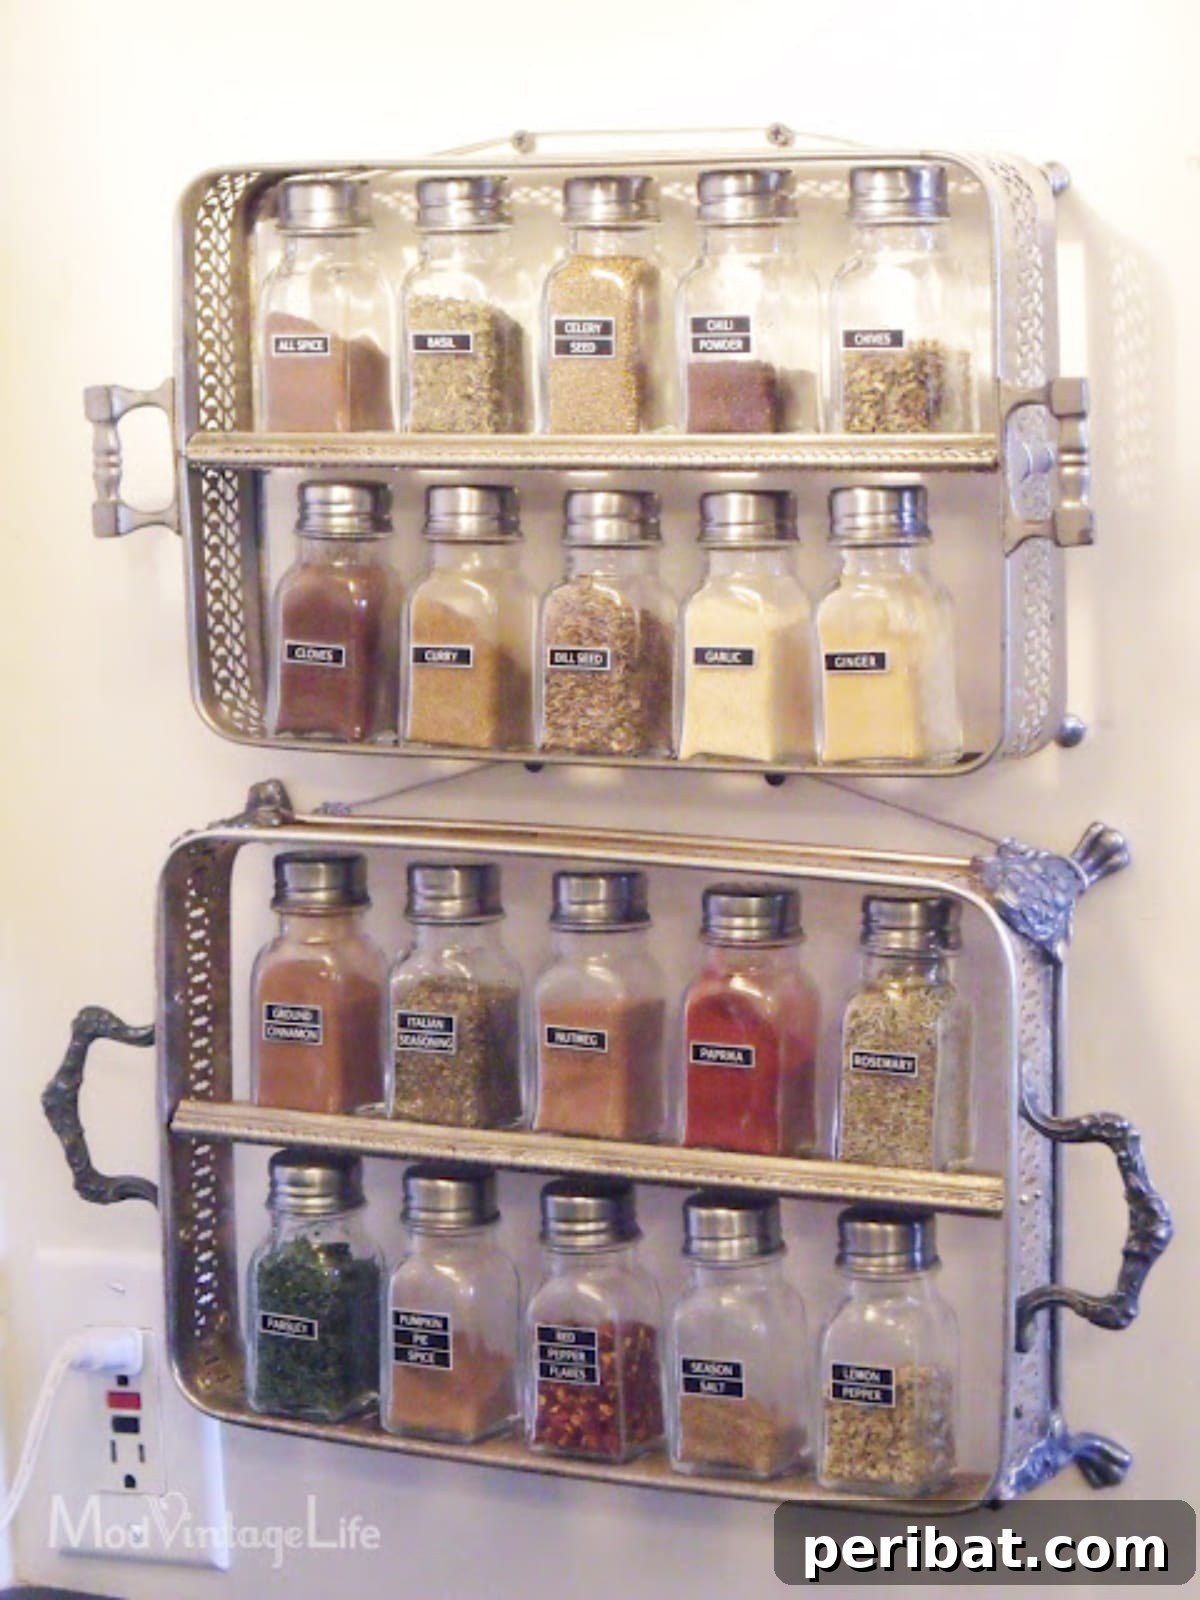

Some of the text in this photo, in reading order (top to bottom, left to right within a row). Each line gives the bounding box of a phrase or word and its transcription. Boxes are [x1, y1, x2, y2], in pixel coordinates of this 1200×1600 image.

[565, 322, 602, 333] CELERY
[569, 341, 596, 353] SEED
[699, 339, 743, 351] POWDER
[295, 647, 333, 661] CLOVES
[425, 649, 458, 661] CURRY
[577, 652, 603, 664] SEED
[705, 650, 742, 663] GARLIC
[834, 655, 876, 667] GINGER
[271, 1008, 313, 1022] GROUND
[407, 1015, 444, 1029] ITALIAN
[266, 1026, 317, 1041] CINNAMON
[399, 1033, 453, 1048] SEASONING
[554, 1032, 598, 1046] NUTMEG
[699, 1047, 744, 1062] PAPRIKA
[854, 1055, 913, 1070] ROSEMARY
[399, 1314, 443, 1329] PUMPKIN
[556, 1331, 576, 1343] RED
[690, 1361, 734, 1376] SEASON
[843, 1367, 880, 1381] LEMON
